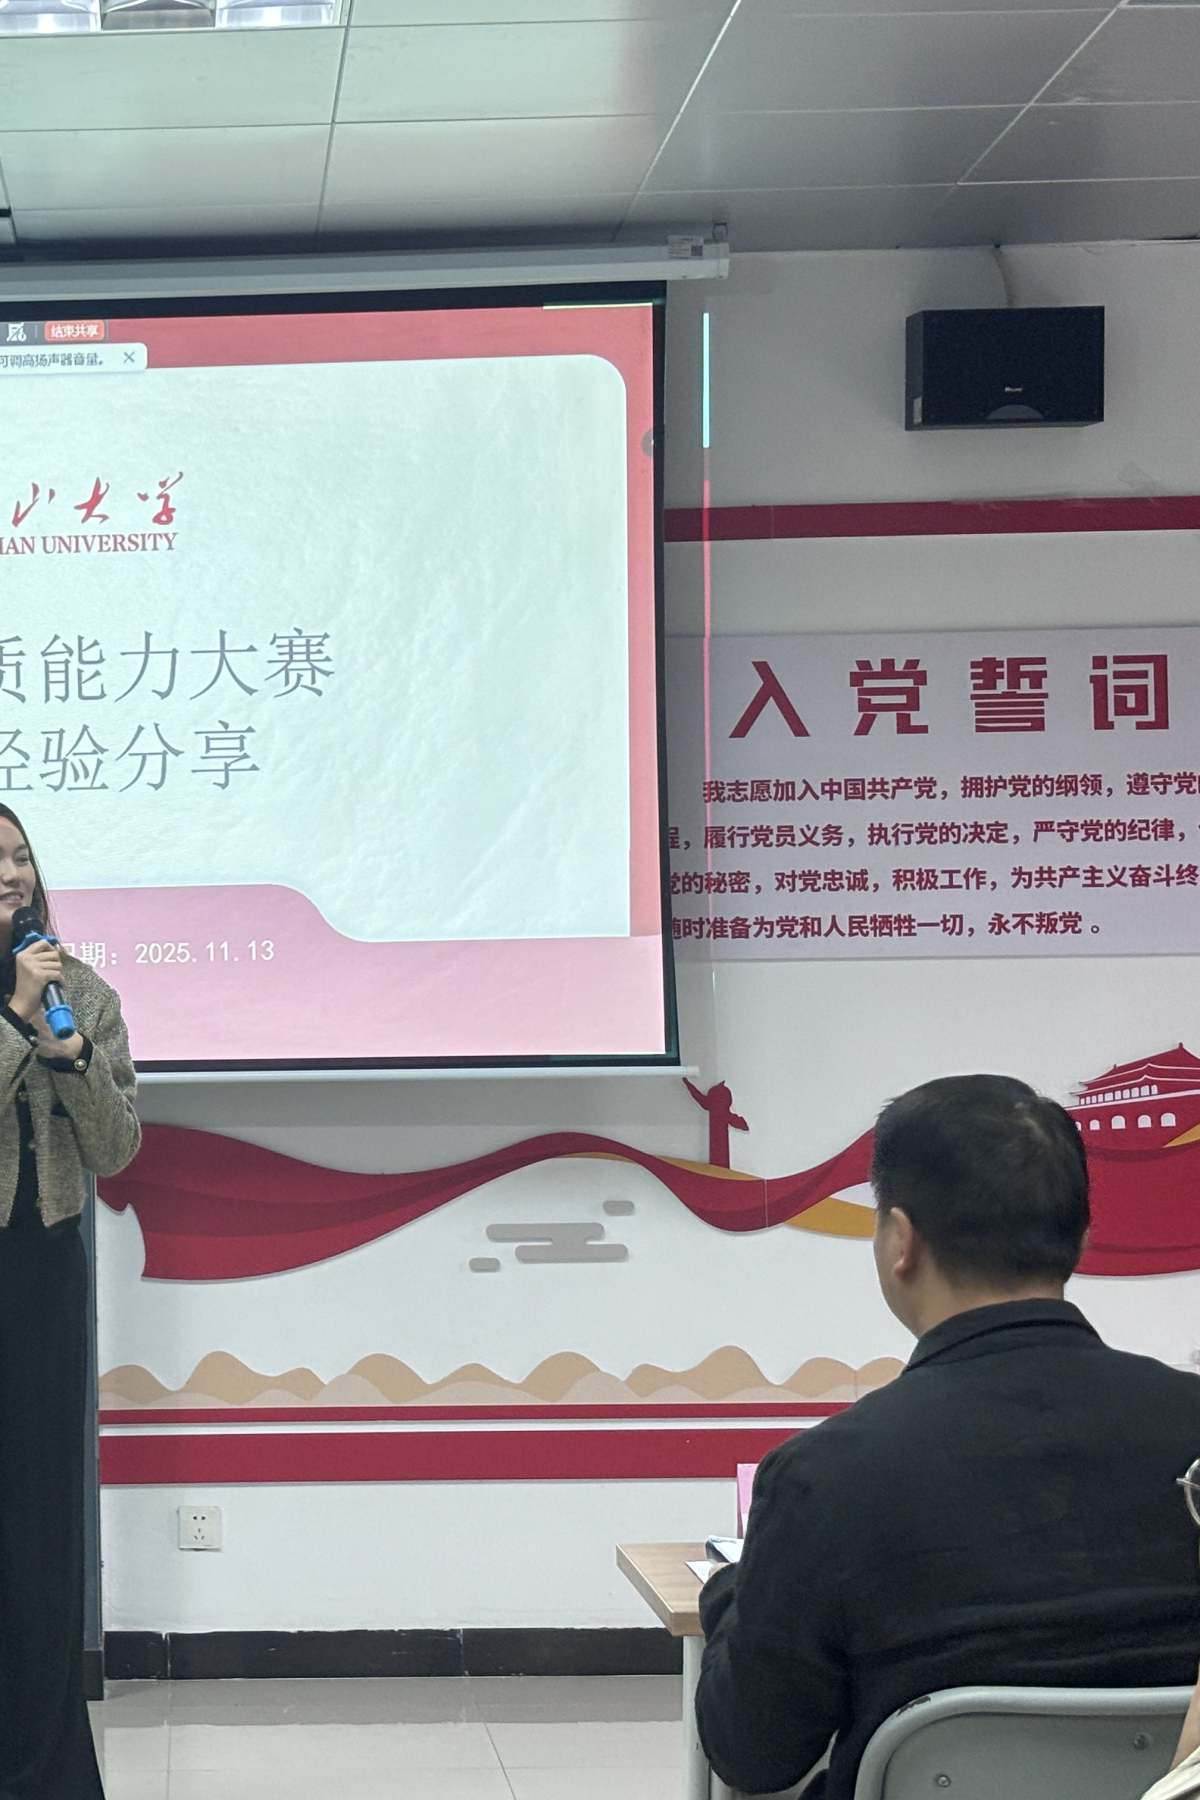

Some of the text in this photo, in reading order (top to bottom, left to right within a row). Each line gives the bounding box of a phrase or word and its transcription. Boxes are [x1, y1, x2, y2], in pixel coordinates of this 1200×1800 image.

[50, 323, 98, 338] 结束共享
[42, 532, 178, 554] UNIVERSITY
[728, 653, 1170, 739] 入党誓词
[703, 771, 1200, 803] 我志愿加入中国共产党，拥护党的纲领，遵守党
